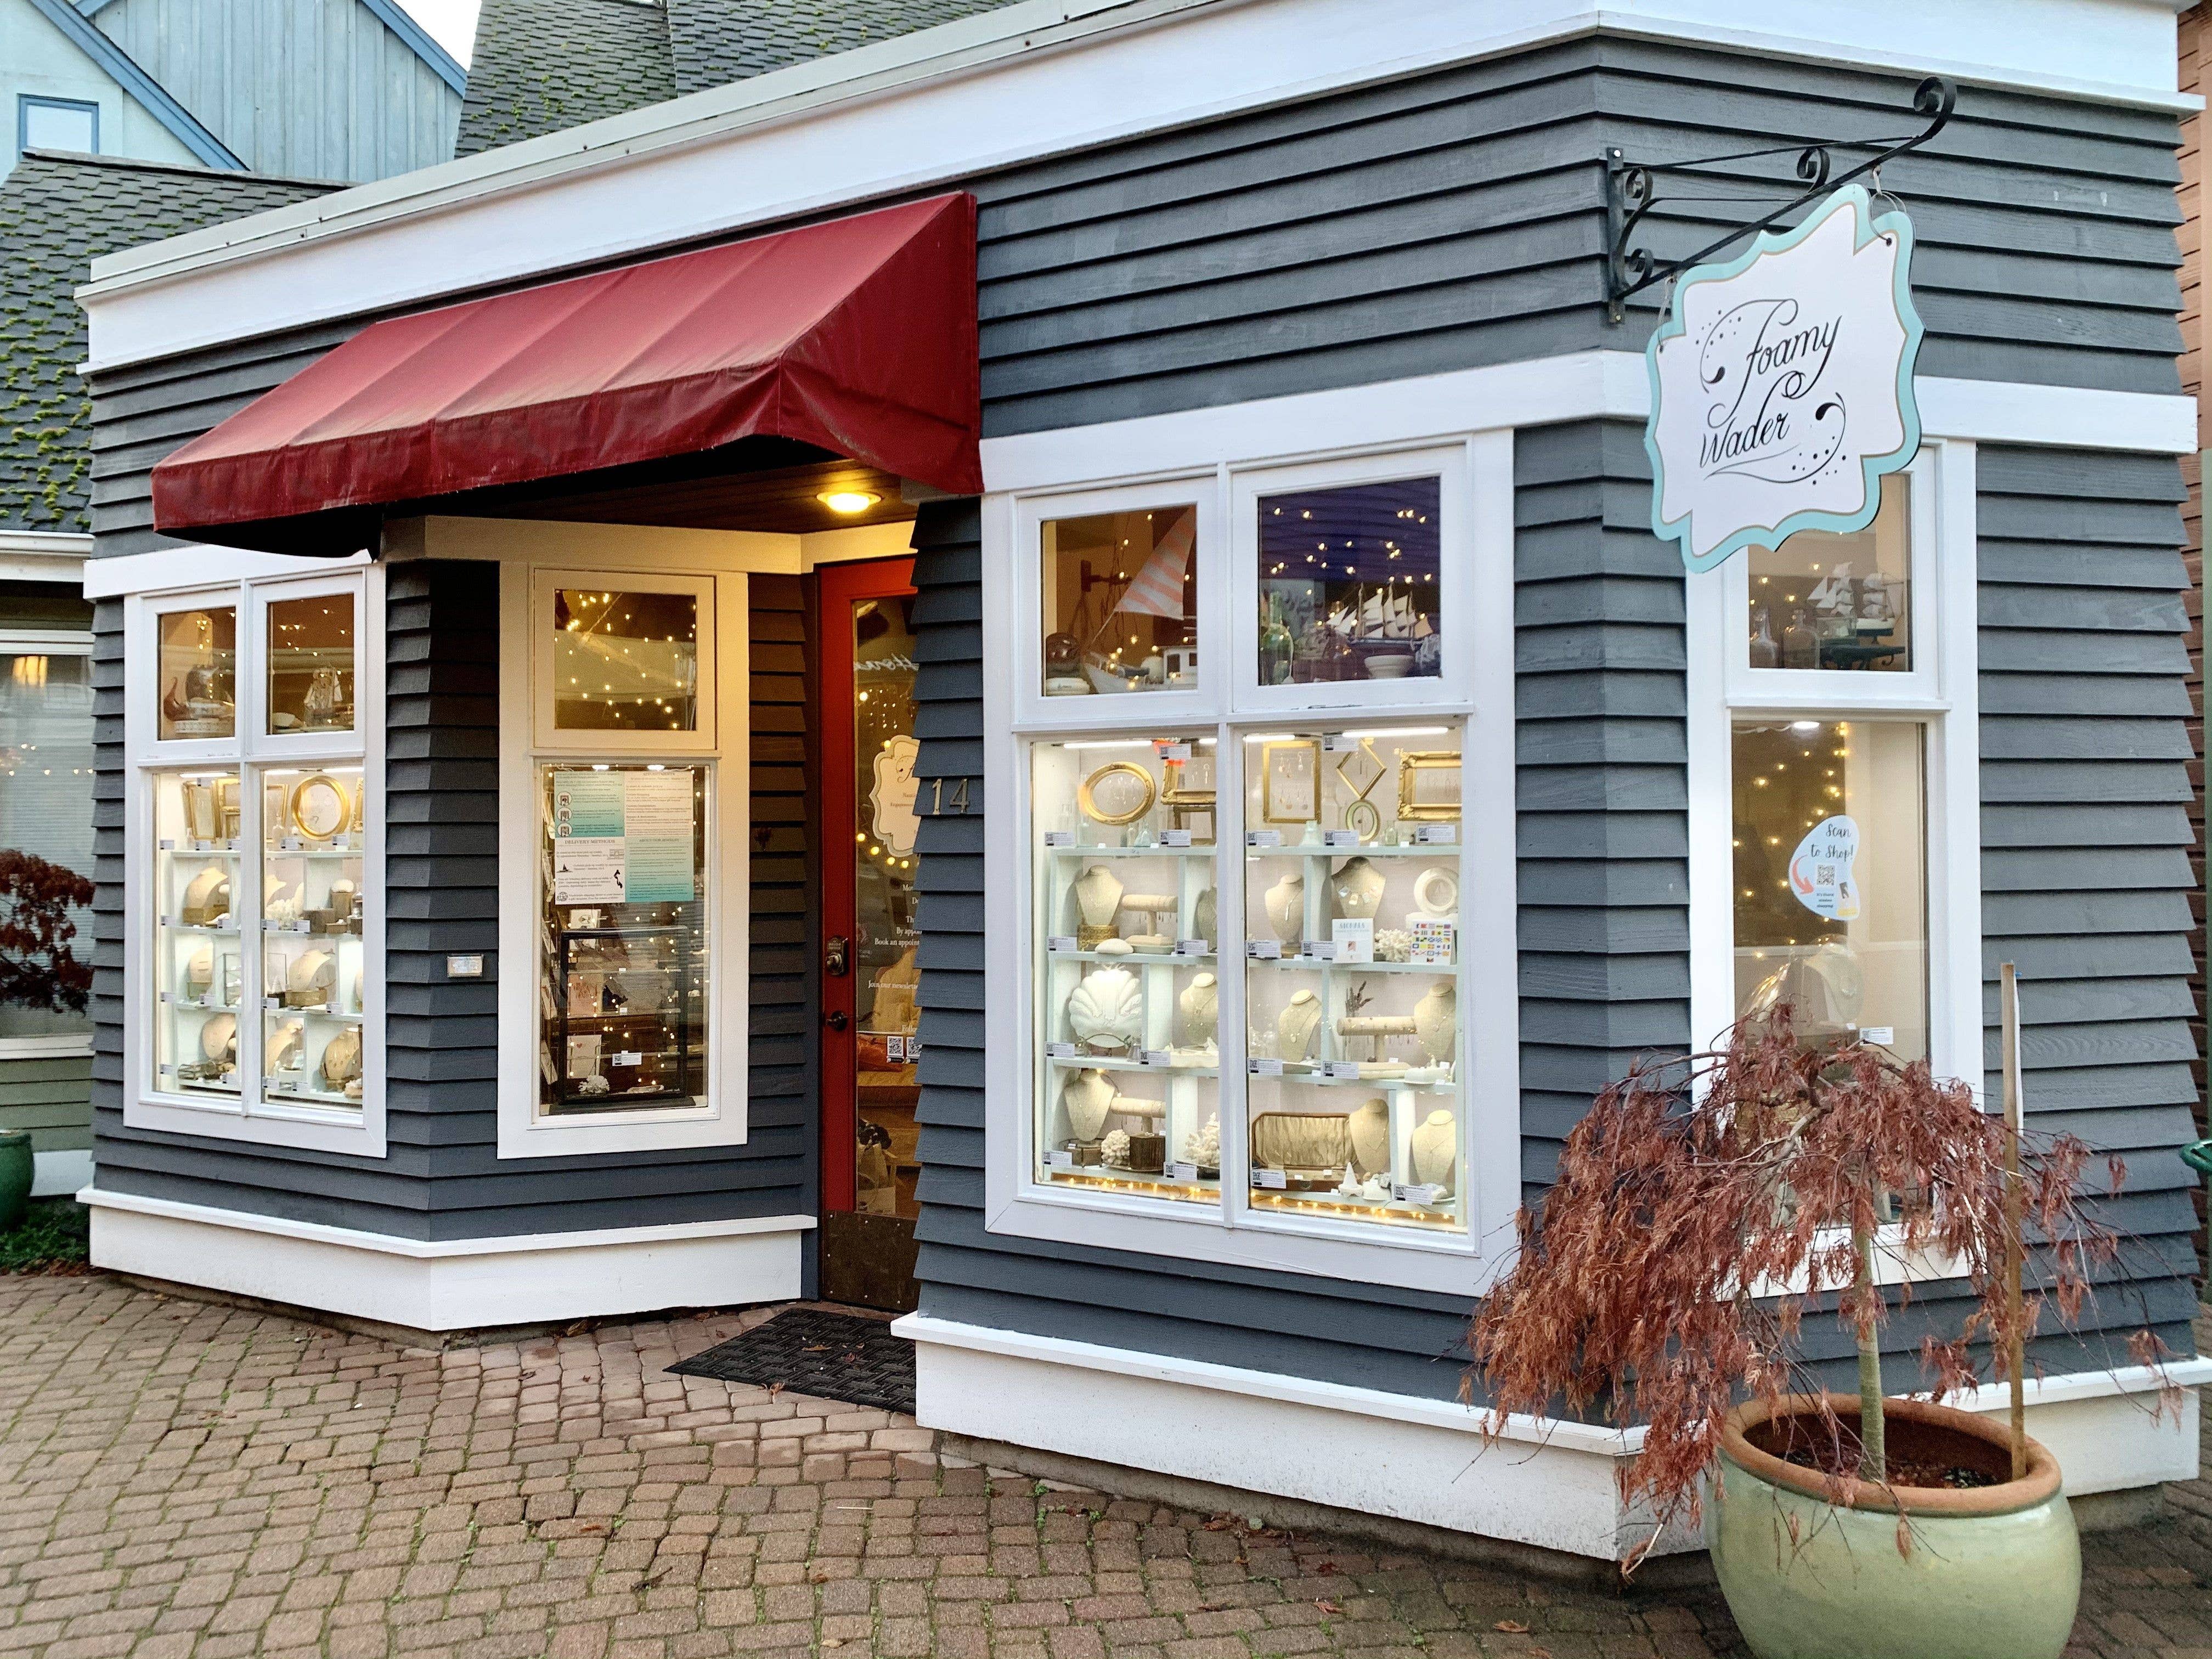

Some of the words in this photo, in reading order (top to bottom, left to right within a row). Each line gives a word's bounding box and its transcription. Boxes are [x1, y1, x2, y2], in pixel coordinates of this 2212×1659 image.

[1708, 299, 1842, 422] Foamy
[1700, 377, 1795, 468] Wader
[932, 778, 970, 815] 14
[1826, 823, 1852, 838] Scan
[1810, 844, 1821, 857] to
[896, 927, 904, 936] By
[874, 937, 889, 945] Book
[868, 980, 879, 989] Join
